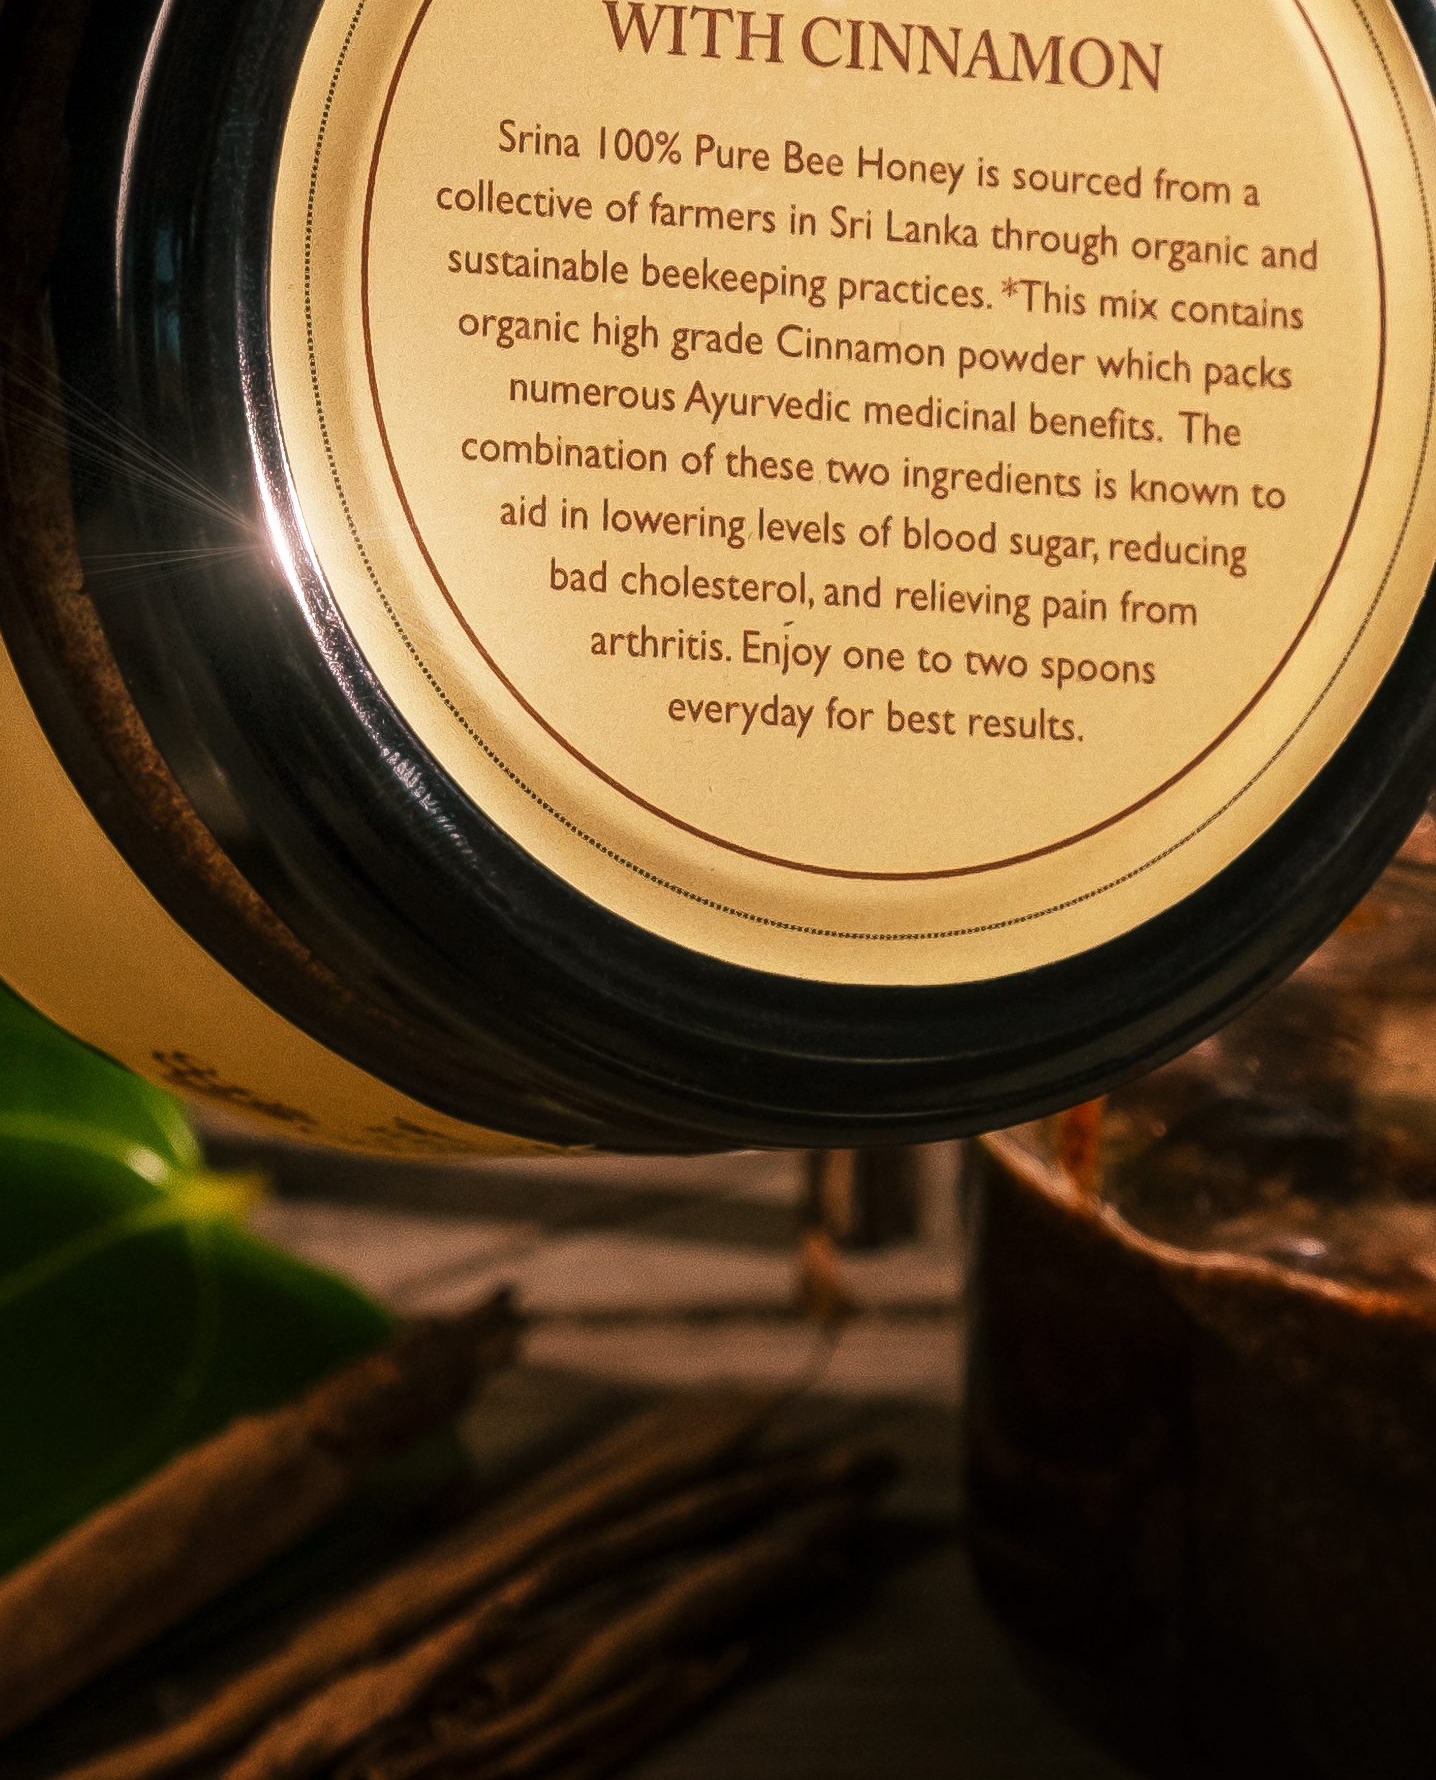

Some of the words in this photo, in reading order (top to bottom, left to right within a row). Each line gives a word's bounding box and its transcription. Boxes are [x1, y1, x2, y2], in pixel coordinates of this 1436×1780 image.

[602, 0, 784, 65] WITH
[801, 16, 1163, 92] CINNAMON
[498, 118, 581, 158] Srina
[599, 126, 682, 166] 100%
[695, 133, 770, 172] Pure
[784, 139, 844, 178] Bee
[857, 146, 965, 195] Honey
[977, 165, 1000, 188] is
[1013, 166, 1142, 199] sourced
[1154, 168, 1231, 205] from
[1244, 184, 1260, 207] a
[436, 179, 593, 220] collective
[605, 190, 640, 224] of
[649, 192, 776, 234] farmers
[790, 203, 816, 236] in
[830, 205, 872, 240] Sri
[886, 209, 978, 248] Lanka
[992, 218, 1118, 266] through
[1131, 237, 1248, 272] organic
[1261, 240, 1317, 271] and
[448, 247, 629, 286] sustainable
[642, 253, 827, 308] beekeeping
[838, 275, 992, 310] practices.
[1099, 295, 1158, 320] mix
[1170, 300, 1304, 330] contains
[458, 311, 579, 350] organic
[593, 311, 659, 358] high
[670, 320, 763, 361] grade
[776, 322, 945, 367] Cinnamon
[958, 342, 1085, 379] powder
[1097, 347, 1191, 383] which
[1204, 356, 1292, 395] packs
[509, 378, 676, 412] numerous
[684, 380, 850, 425] Ayurvedic
[864, 396, 1016, 433] medicinal
[1029, 402, 1163, 442] benefits.
[1178, 411, 1241, 447] The
[461, 432, 667, 472] combination
[681, 442, 716, 476] of
[725, 444, 814, 482] these
[826, 458, 890, 486] two
[903, 457, 1081, 500] ingredients
[1095, 477, 1117, 501] is
[1130, 469, 1239, 506] known
[1252, 484, 1286, 510] to
[500, 494, 547, 528] aid
[561, 498, 589, 530] in
[602, 498, 746, 550] lowering
[758, 507, 846, 546] levels
[858, 515, 893, 548] of
[903, 516, 997, 554] blood
[1010, 533, 1099, 568] sugar,
[1109, 531, 1247, 578] reducing
[550, 557, 607, 593] bad
[621, 562, 815, 609] cholesterol,
[824, 576, 881, 609] and
[895, 579, 1031, 627] relieving
[1042, 590, 1107, 629] pain
[1120, 589, 1197, 626] from
[591, 624, 732, 662] arthritis.
[742, 627, 831, 677] Enjoy
[843, 646, 905, 672] one
[917, 647, 953, 674] to
[965, 651, 1028, 678] two
[1041, 656, 1156, 690] spoons
[668, 693, 814, 739] everyday
[825, 696, 874, 731] for
[887, 699, 956, 736] best
[968, 707, 1083, 742] results.
